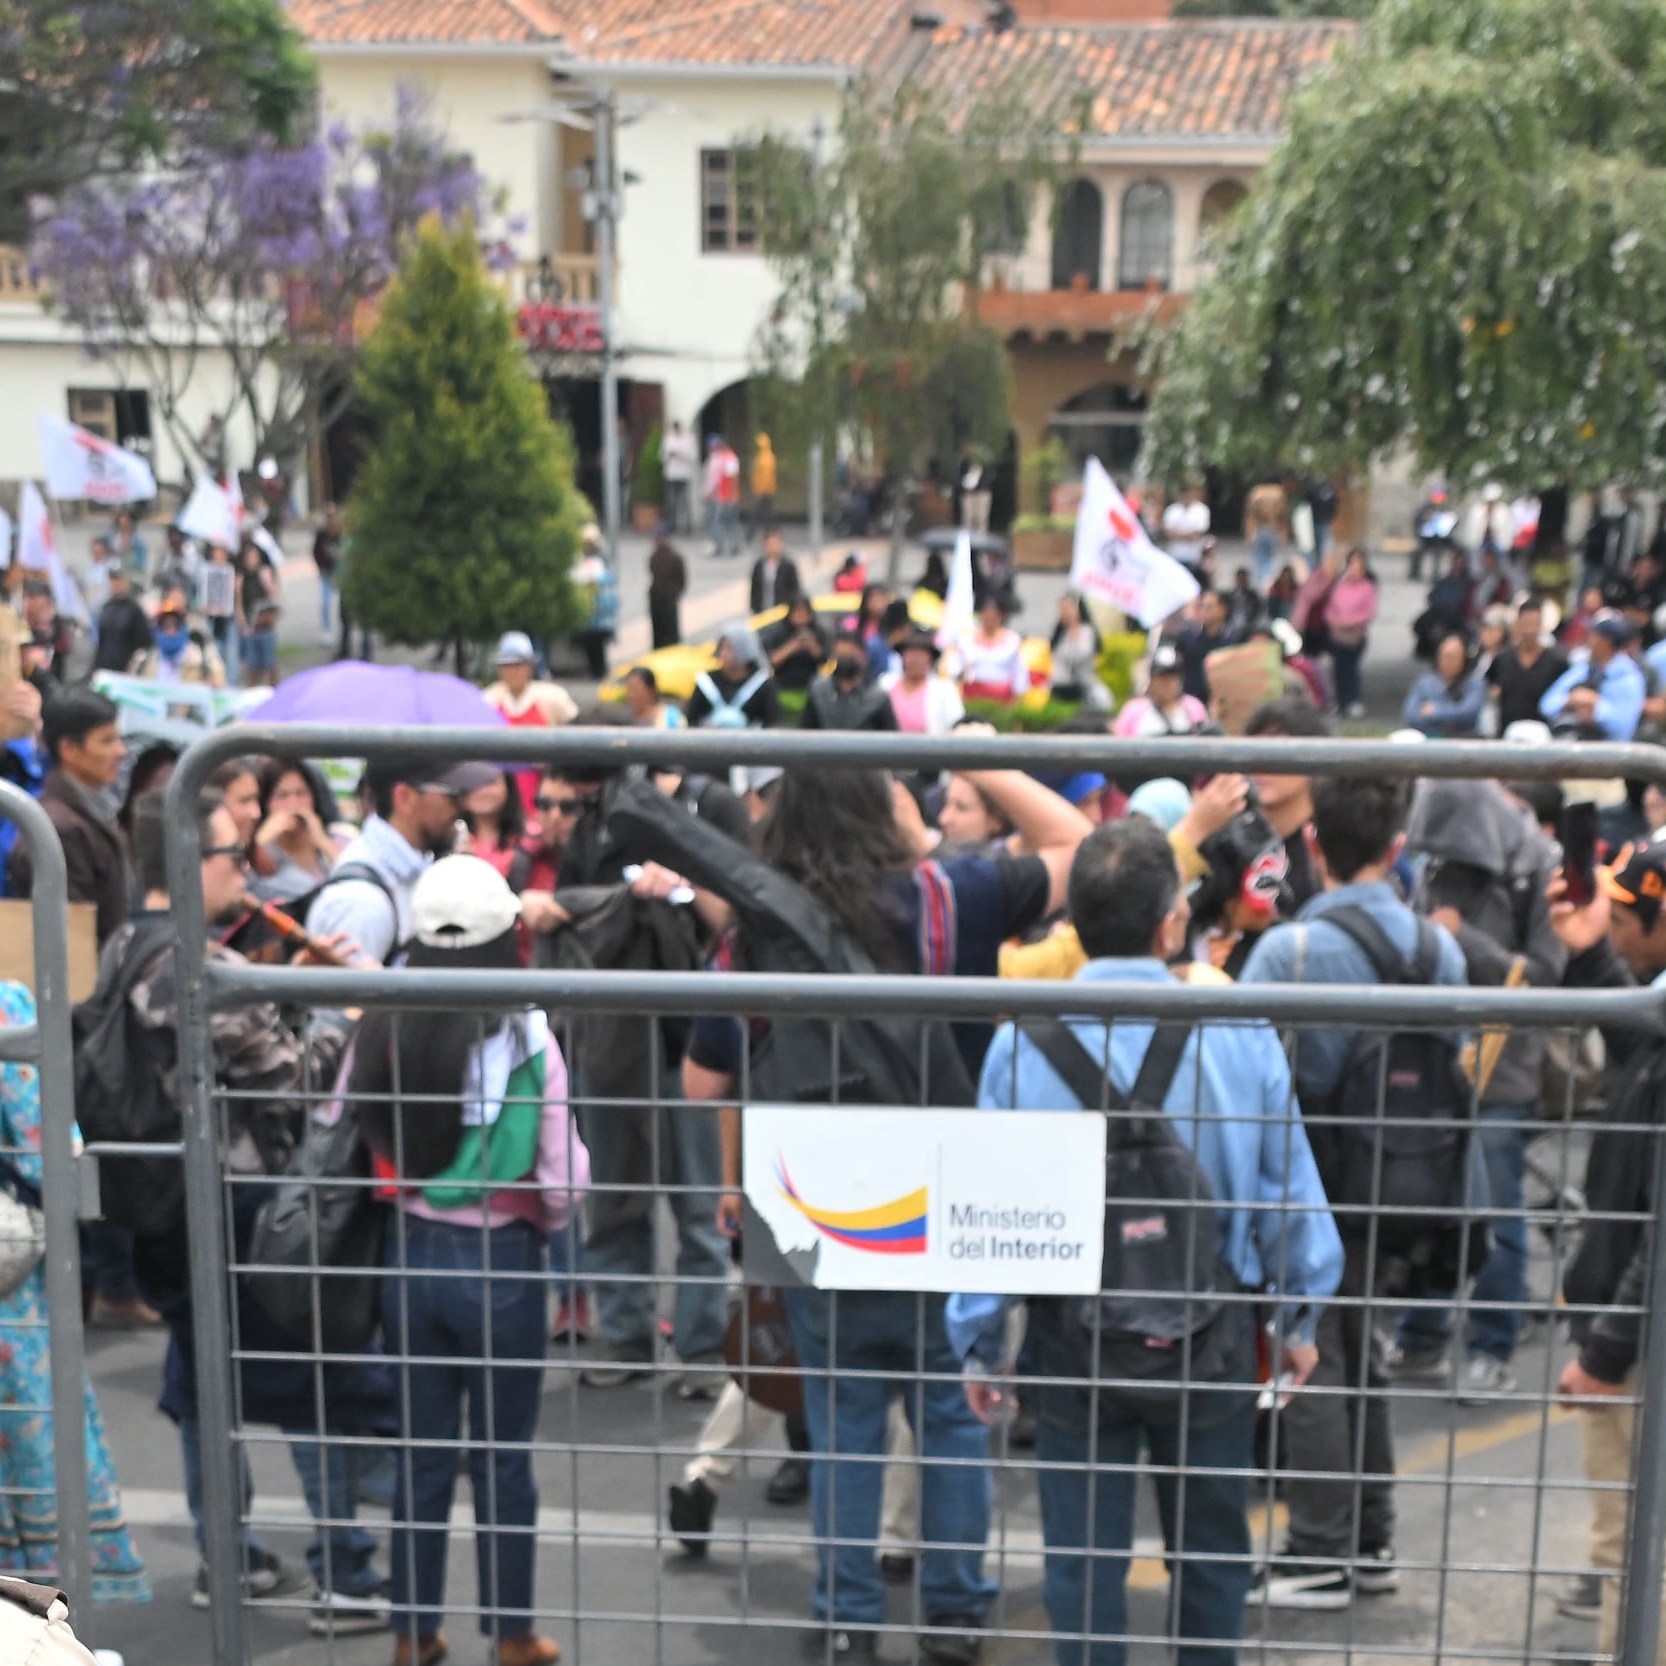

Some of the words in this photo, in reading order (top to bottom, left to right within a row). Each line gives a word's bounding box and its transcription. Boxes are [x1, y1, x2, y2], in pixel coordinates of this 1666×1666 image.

[949, 1203, 1067, 1231] Ministerio
[949, 1236, 986, 1260] del
[990, 1236, 1085, 1260] Interior
